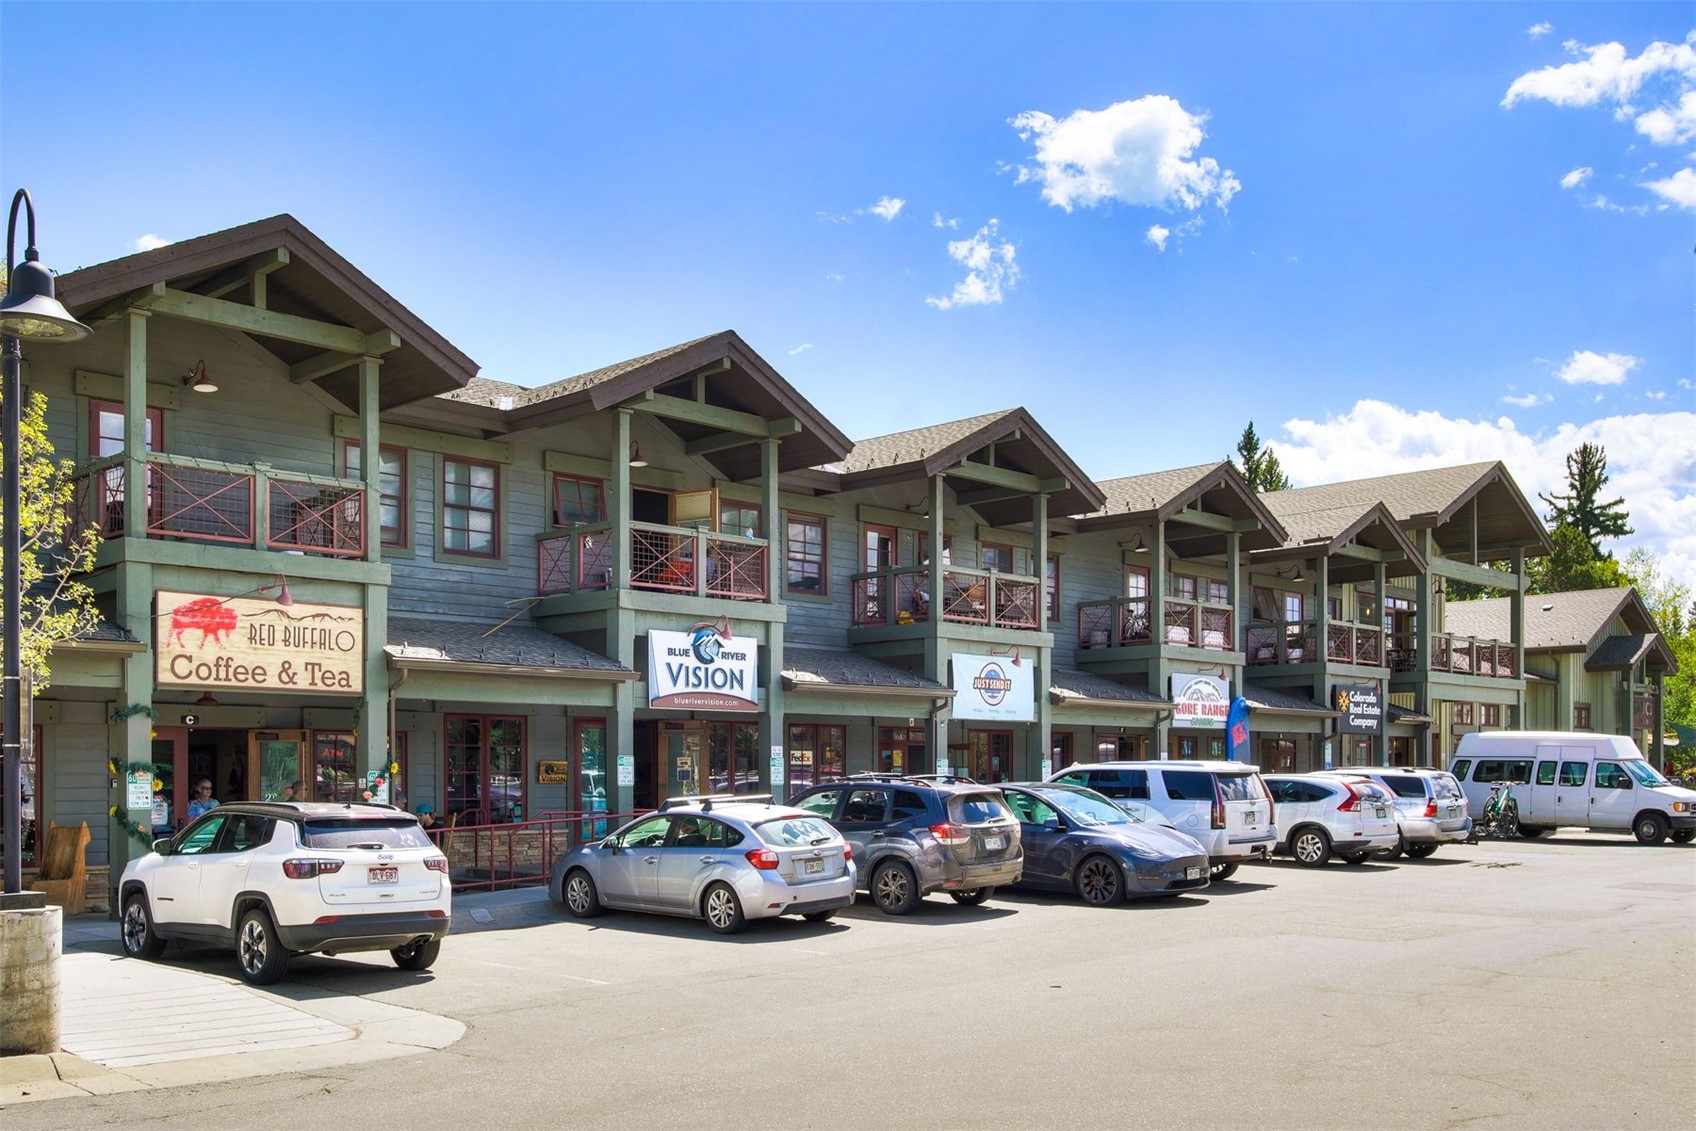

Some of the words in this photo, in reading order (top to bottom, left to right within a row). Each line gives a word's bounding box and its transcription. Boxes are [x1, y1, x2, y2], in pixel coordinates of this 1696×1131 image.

[247, 623, 275, 647] RED
[281, 626, 355, 652] BUFFALO
[667, 647, 691, 657] BLUE
[721, 651, 747, 661] RIVER
[170, 654, 267, 684] Coffee
[278, 660, 297, 685] &
[304, 662, 352, 688] Tea
[665, 662, 744, 691] VISION
[973, 678, 990, 689] JUST
[990, 679, 1004, 690] SEND
[1004, 680, 1011, 690] IT
[674, 697, 739, 706] bluerivervision.com
[1349, 691, 1377, 703] Colorado
[1175, 701, 1198, 715] GORE
[1201, 703, 1230, 717] RANGE
[1350, 703, 1362, 714] Real
[1363, 704, 1381, 715] Estate
[185, 715, 195, 725] C
[1349, 715, 1377, 729] Company
[322, 747, 344, 759] ATM
[791, 753, 811, 762] FedEx
[541, 775, 566, 783] VISION
